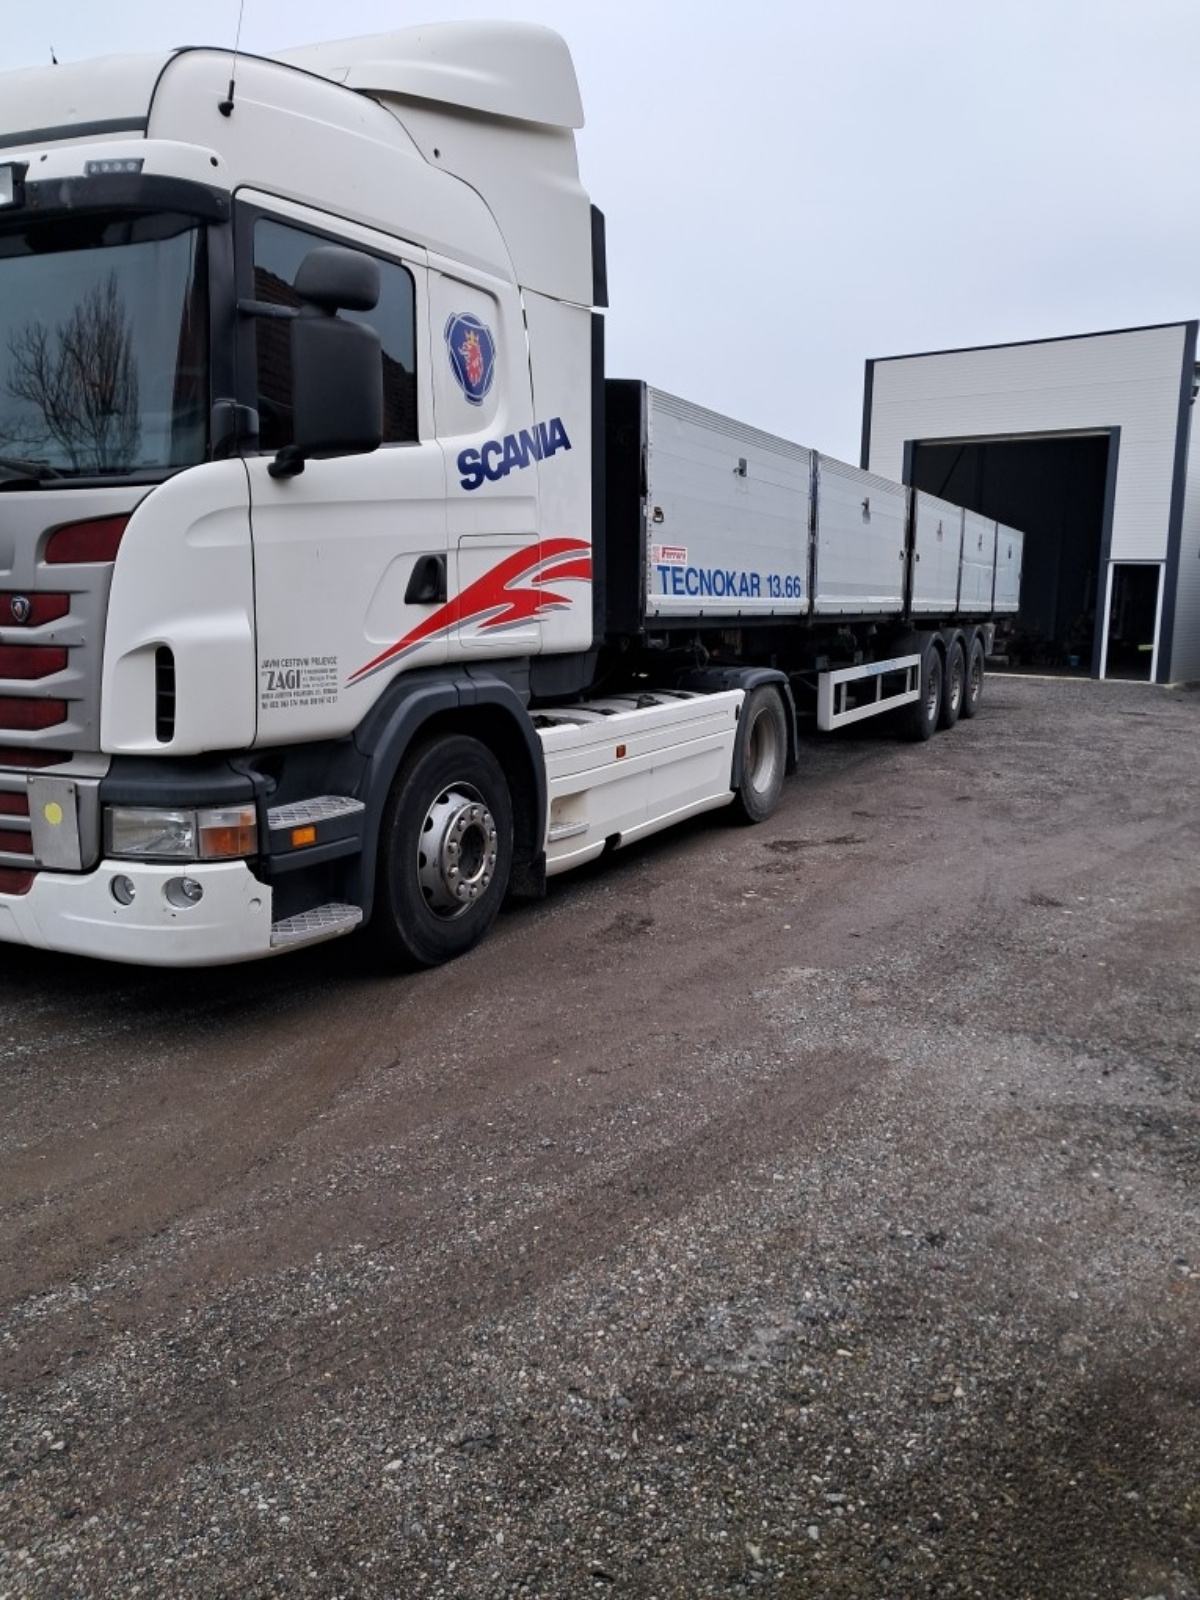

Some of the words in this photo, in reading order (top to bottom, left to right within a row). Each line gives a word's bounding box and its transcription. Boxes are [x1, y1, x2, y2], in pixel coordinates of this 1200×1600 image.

[457, 417, 572, 491] SCANIA
[657, 565, 761, 597] TECNOKAR
[767, 574, 801, 598] 13.66
[267, 669, 301, 691] ZAGI
